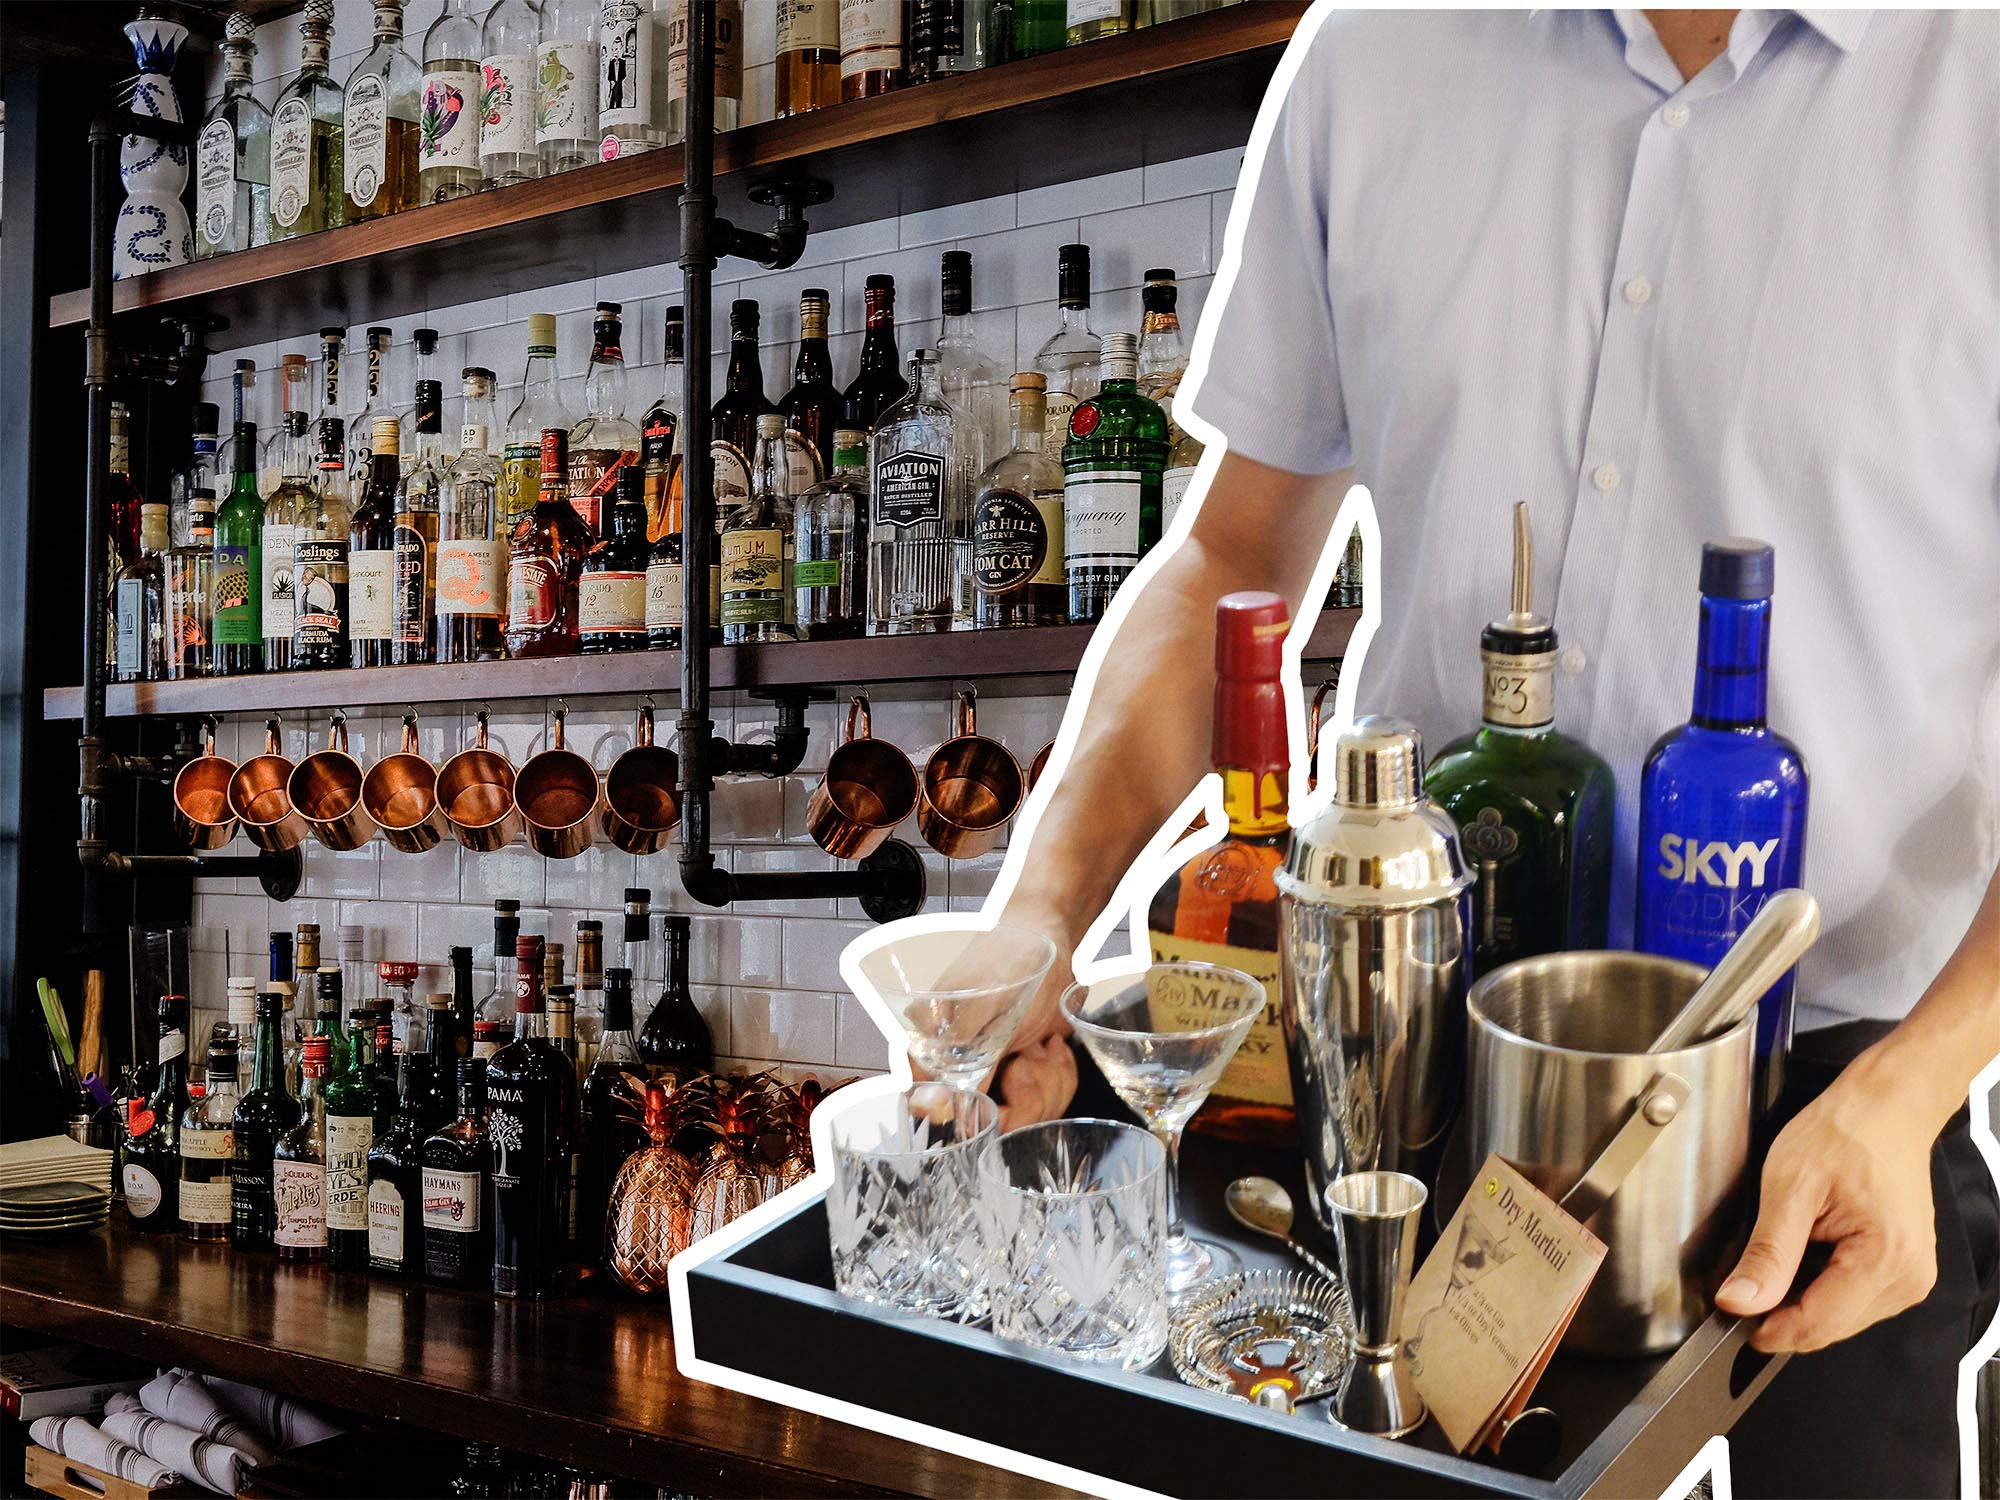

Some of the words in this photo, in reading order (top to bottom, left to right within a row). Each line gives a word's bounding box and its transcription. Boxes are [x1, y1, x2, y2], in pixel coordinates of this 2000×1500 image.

[880, 462, 939, 480] AVIATION
[999, 517, 1038, 533] HILL
[981, 531, 1015, 540] RESERVE
[294, 545, 341, 561] Goslings
[998, 554, 1033, 569] CAT
[988, 571, 1002, 579] GIN
[1103, 573, 1120, 583] GIN
[652, 585, 665, 600] 15
[584, 594, 597, 608] 12
[1658, 832, 1780, 889] SKYY
[487, 1086, 524, 1103] PAMA
[424, 1176, 462, 1192] HAYMANS
[370, 1200, 400, 1217] HEERING
[1498, 1184, 1526, 1227] Dry
[1520, 1210, 1572, 1272] Martini
[1459, 1316, 1479, 1345] Olives
[1488, 1326, 1520, 1370] Vermouth
